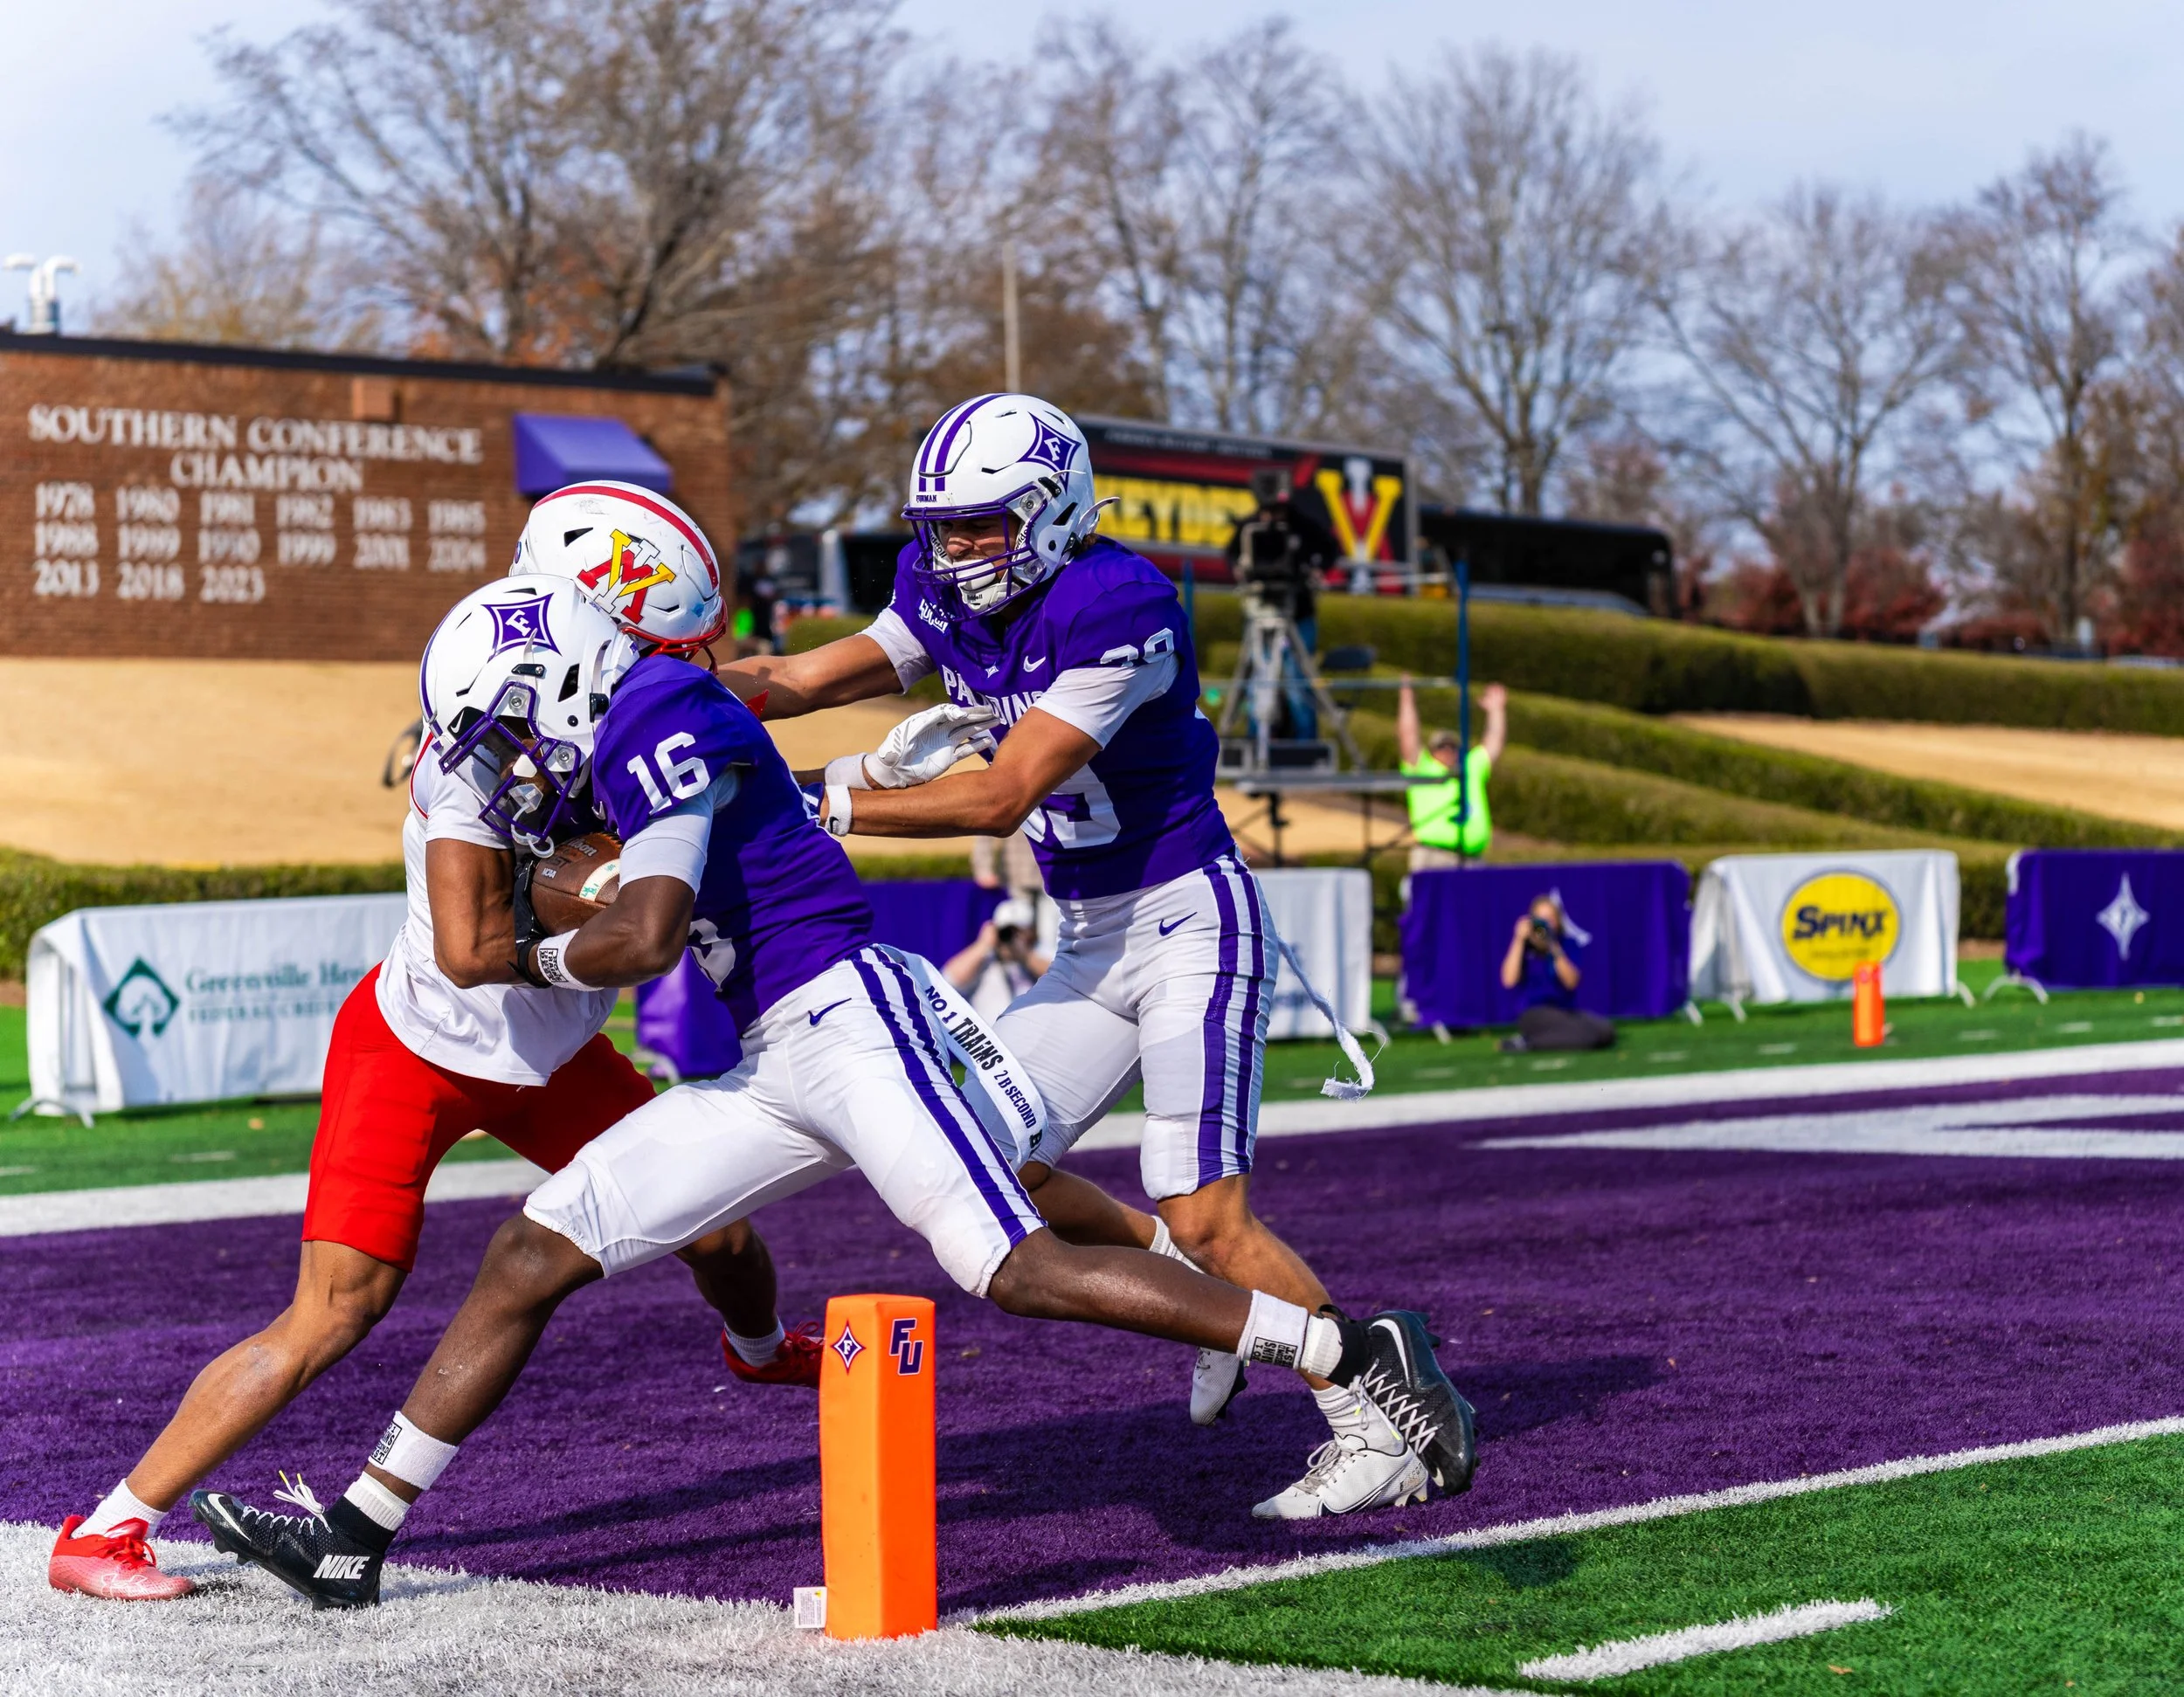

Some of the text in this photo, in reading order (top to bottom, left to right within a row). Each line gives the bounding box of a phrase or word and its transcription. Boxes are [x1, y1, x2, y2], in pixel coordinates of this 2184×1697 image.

[28, 404, 483, 465] SOUTHERN CONFERENCE
[1044, 437, 1061, 462] F
[170, 452, 363, 493] CHAMPION
[35, 481, 95, 521] 1978
[116, 485, 181, 524] 1980
[276, 493, 335, 529] 1982
[916, 494, 937, 503] FURMAN
[278, 530, 337, 566] 1999
[33, 559, 266, 604] 2013 2018 2023
[505, 609, 532, 638] F
[626, 731, 711, 816] 16
[925, 985, 948, 1012] NO
[941, 1011, 957, 1024] 1
[1005, 1086, 1038, 1129] SECOND
[843, 1340, 853, 1355] F
[889, 1317, 924, 1376] FU
[313, 1555, 370, 1580] NIKE
